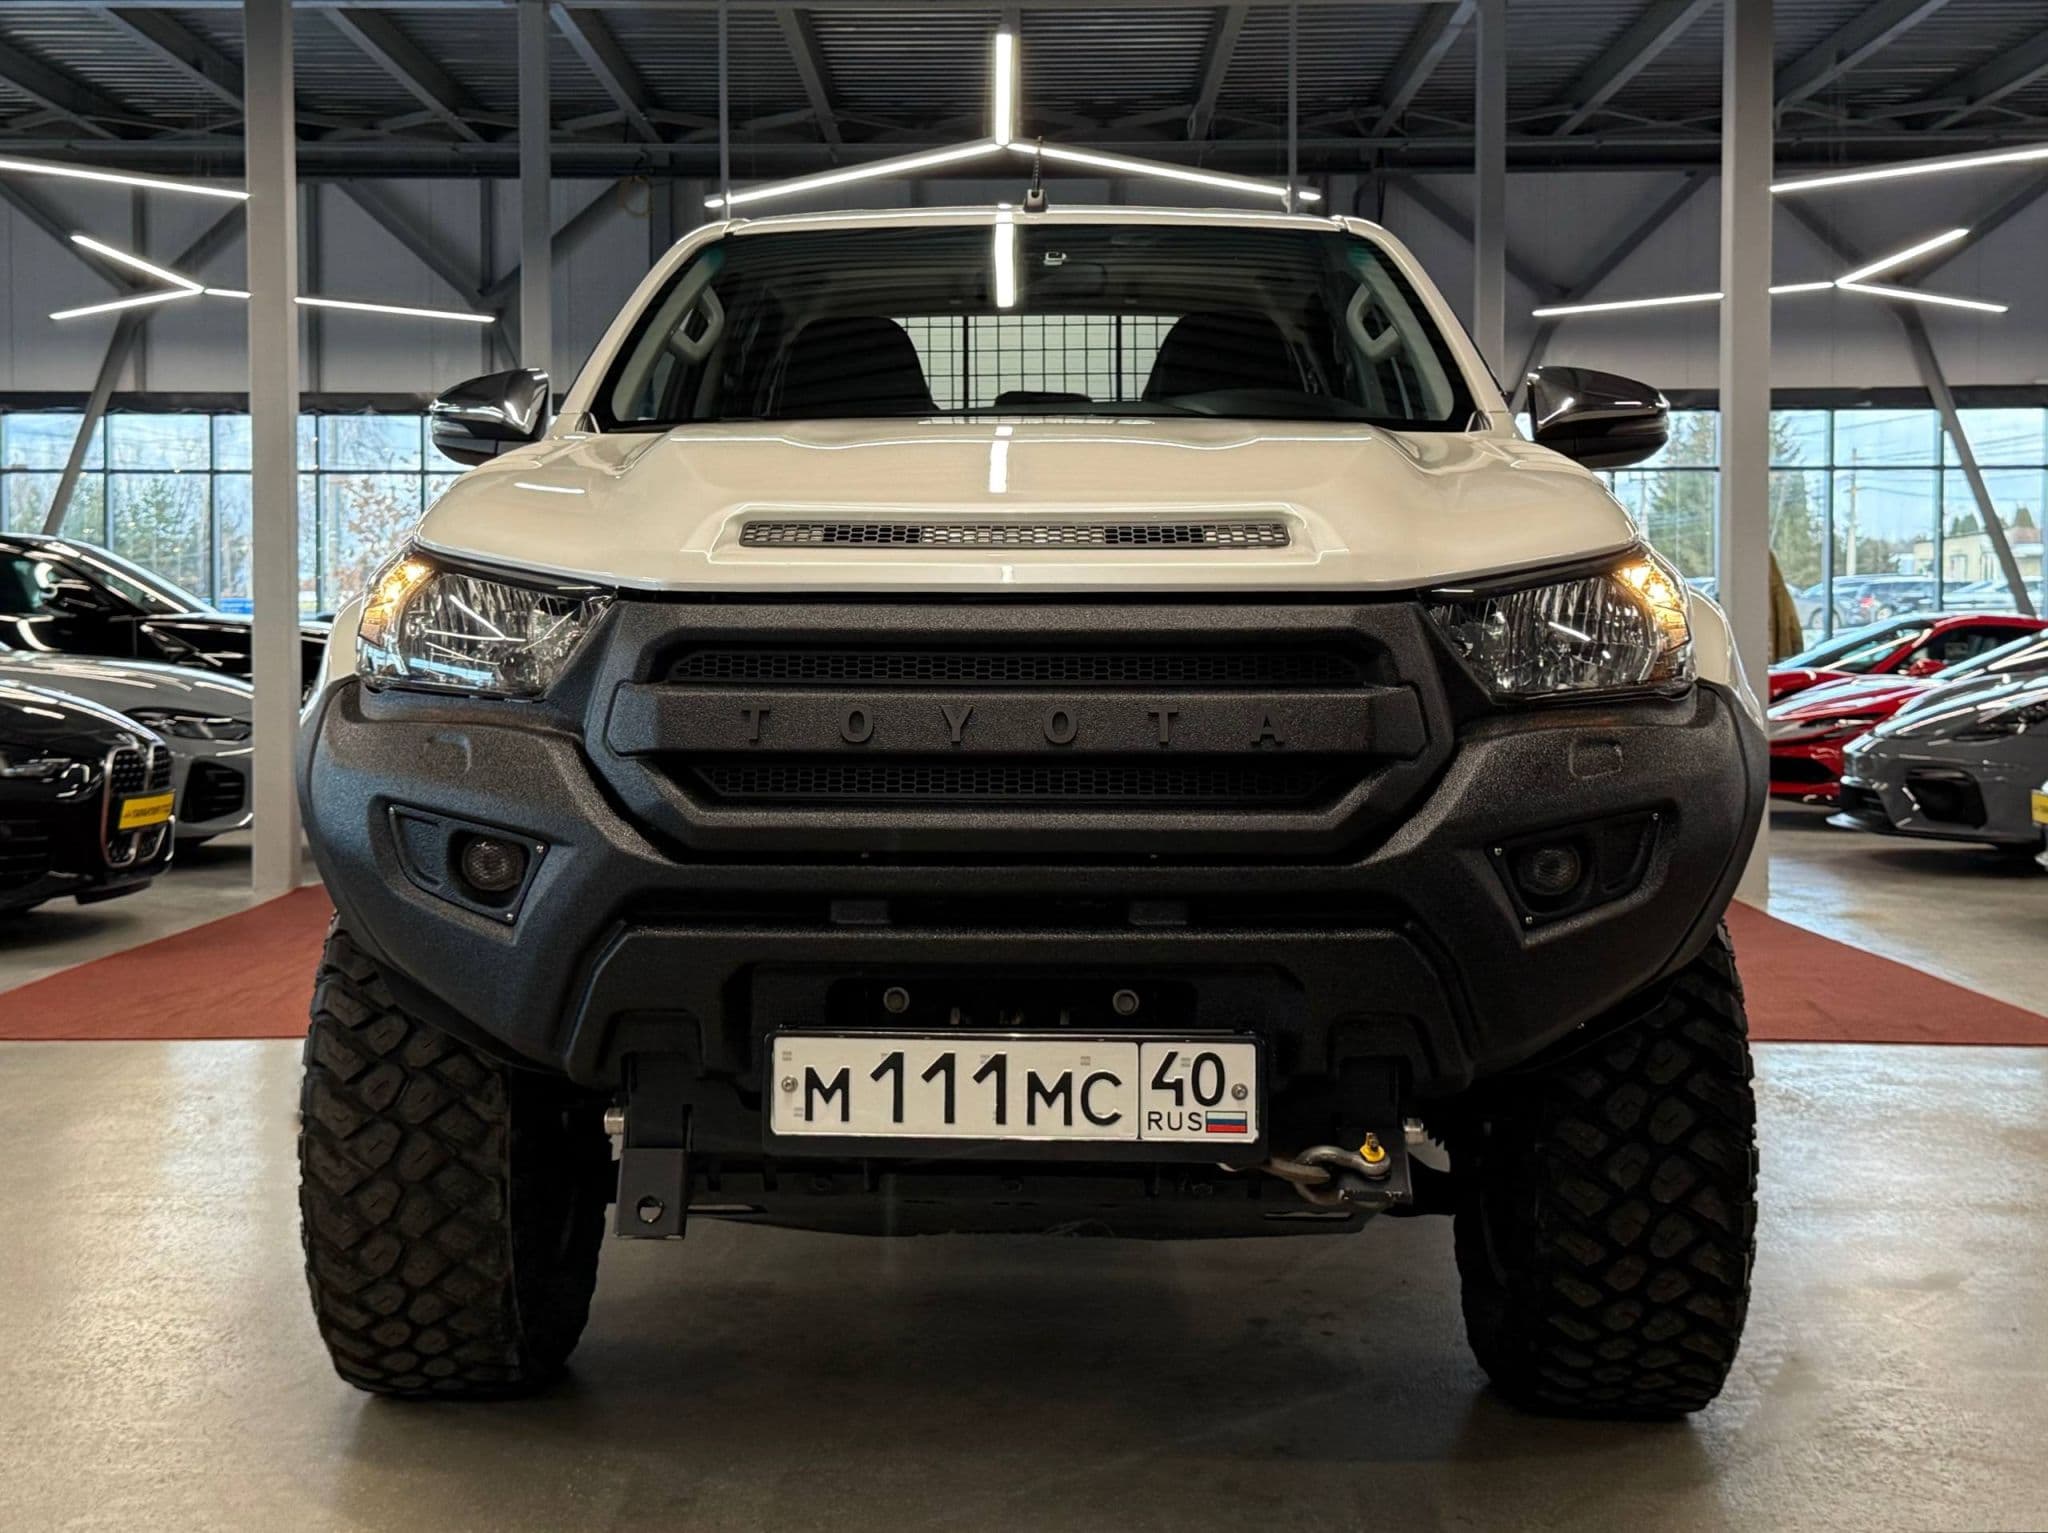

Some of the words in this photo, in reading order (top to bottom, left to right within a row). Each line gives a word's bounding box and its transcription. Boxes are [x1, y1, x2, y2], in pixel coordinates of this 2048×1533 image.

[740, 703, 1286, 745] TOYOTA
[1151, 1051, 1226, 1107] 40
[1147, 1110, 1203, 1132] RUS
